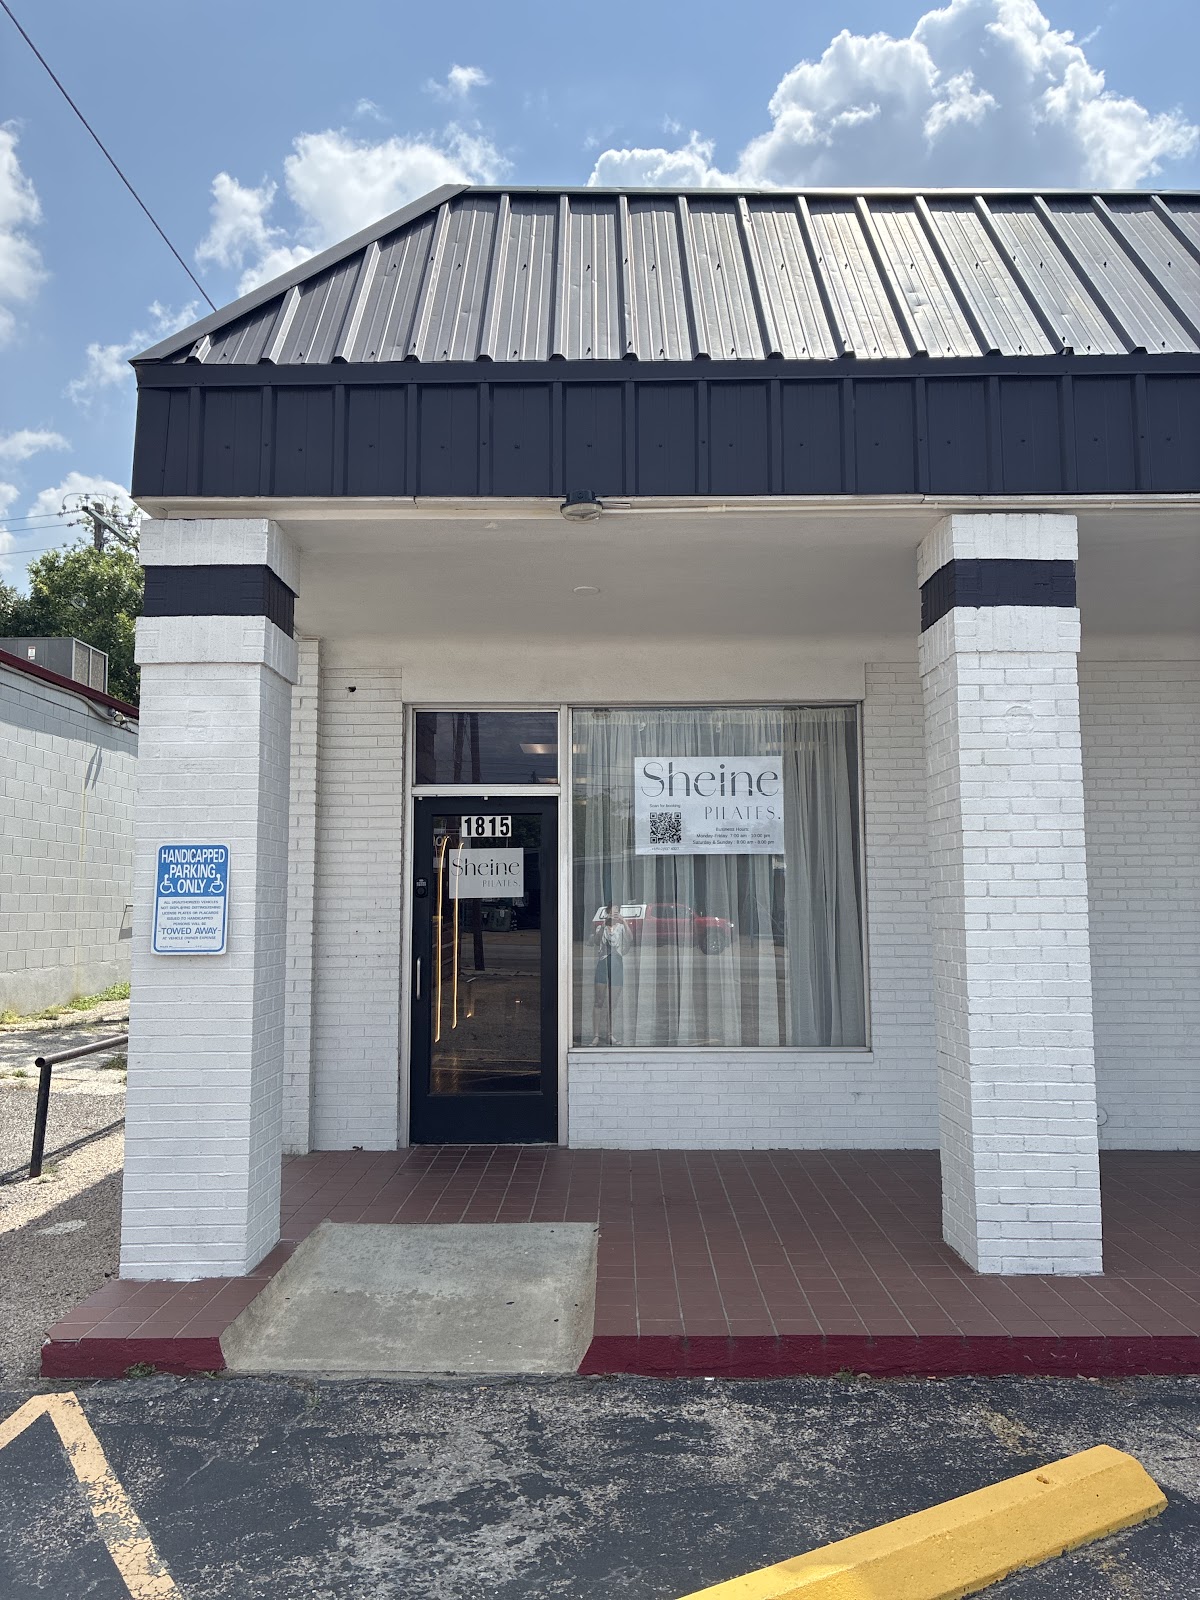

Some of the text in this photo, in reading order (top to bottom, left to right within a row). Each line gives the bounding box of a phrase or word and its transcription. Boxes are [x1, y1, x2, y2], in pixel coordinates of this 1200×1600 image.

[641, 761, 780, 798] Sheine
[464, 816, 510, 836] 1815
[161, 849, 225, 863] HANDICAPPED
[169, 864, 216, 878] PARKING
[450, 858, 521, 877] Sheine
[177, 879, 206, 893] ONLY
